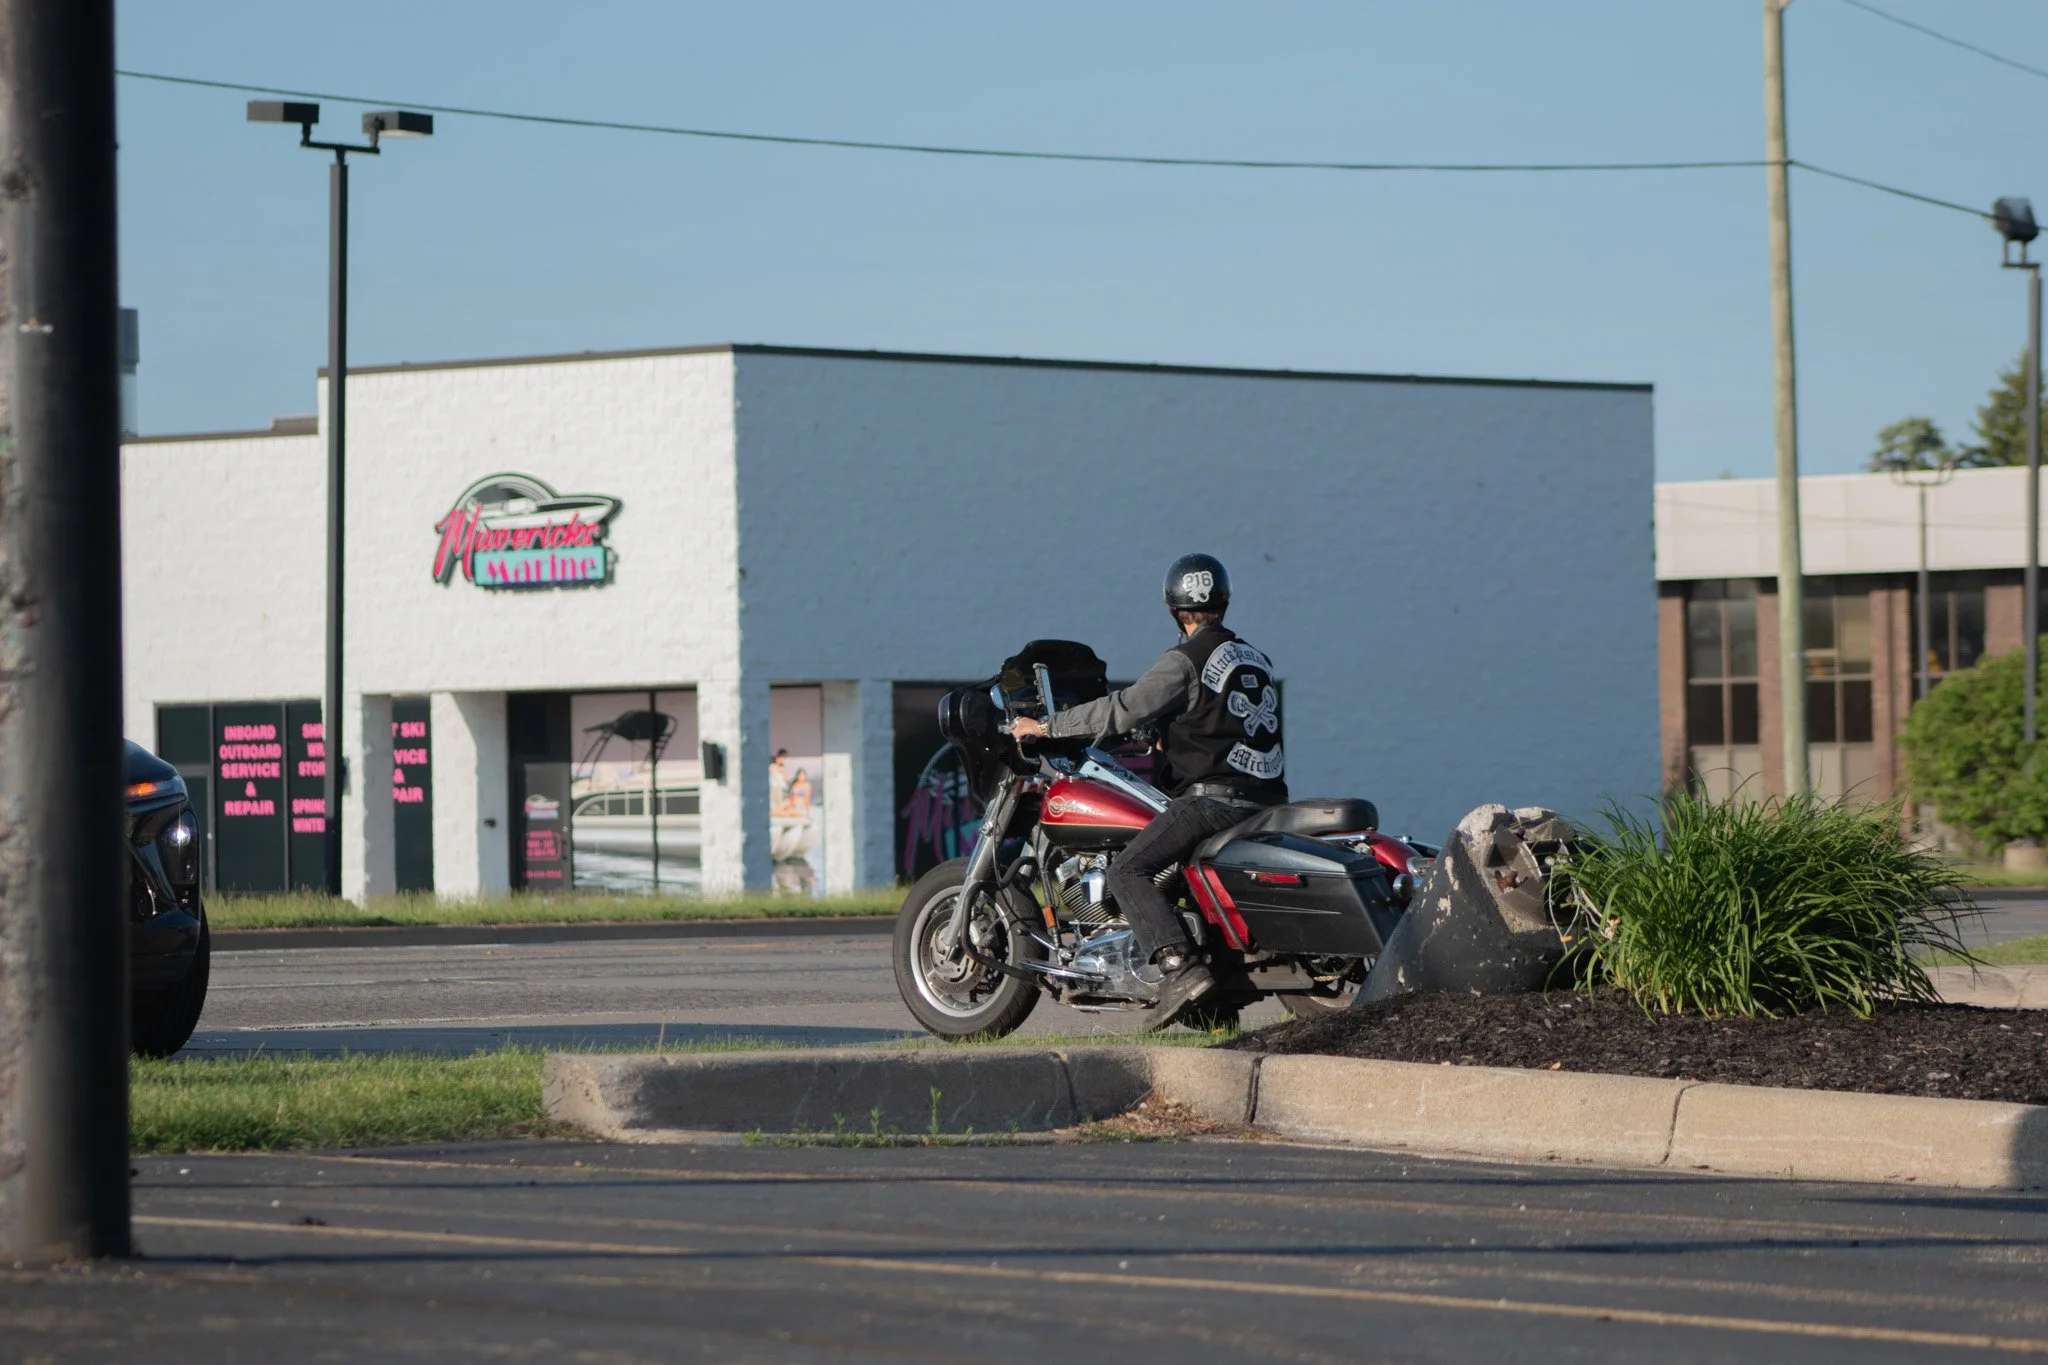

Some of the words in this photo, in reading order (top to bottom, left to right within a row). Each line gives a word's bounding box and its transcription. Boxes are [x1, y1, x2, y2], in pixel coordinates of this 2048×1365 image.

[434, 503, 600, 580] Mavericks
[486, 552, 596, 583] Marine
[1184, 572, 1212, 589] 216
[1204, 647, 1237, 686] Black
[223, 724, 277, 742] INBOARD
[400, 721, 426, 738] SKI
[218, 743, 283, 761] OUTBOARD
[220, 761, 281, 779] SERVICE
[244, 780, 257, 798] &
[224, 799, 276, 817] REPAIR
